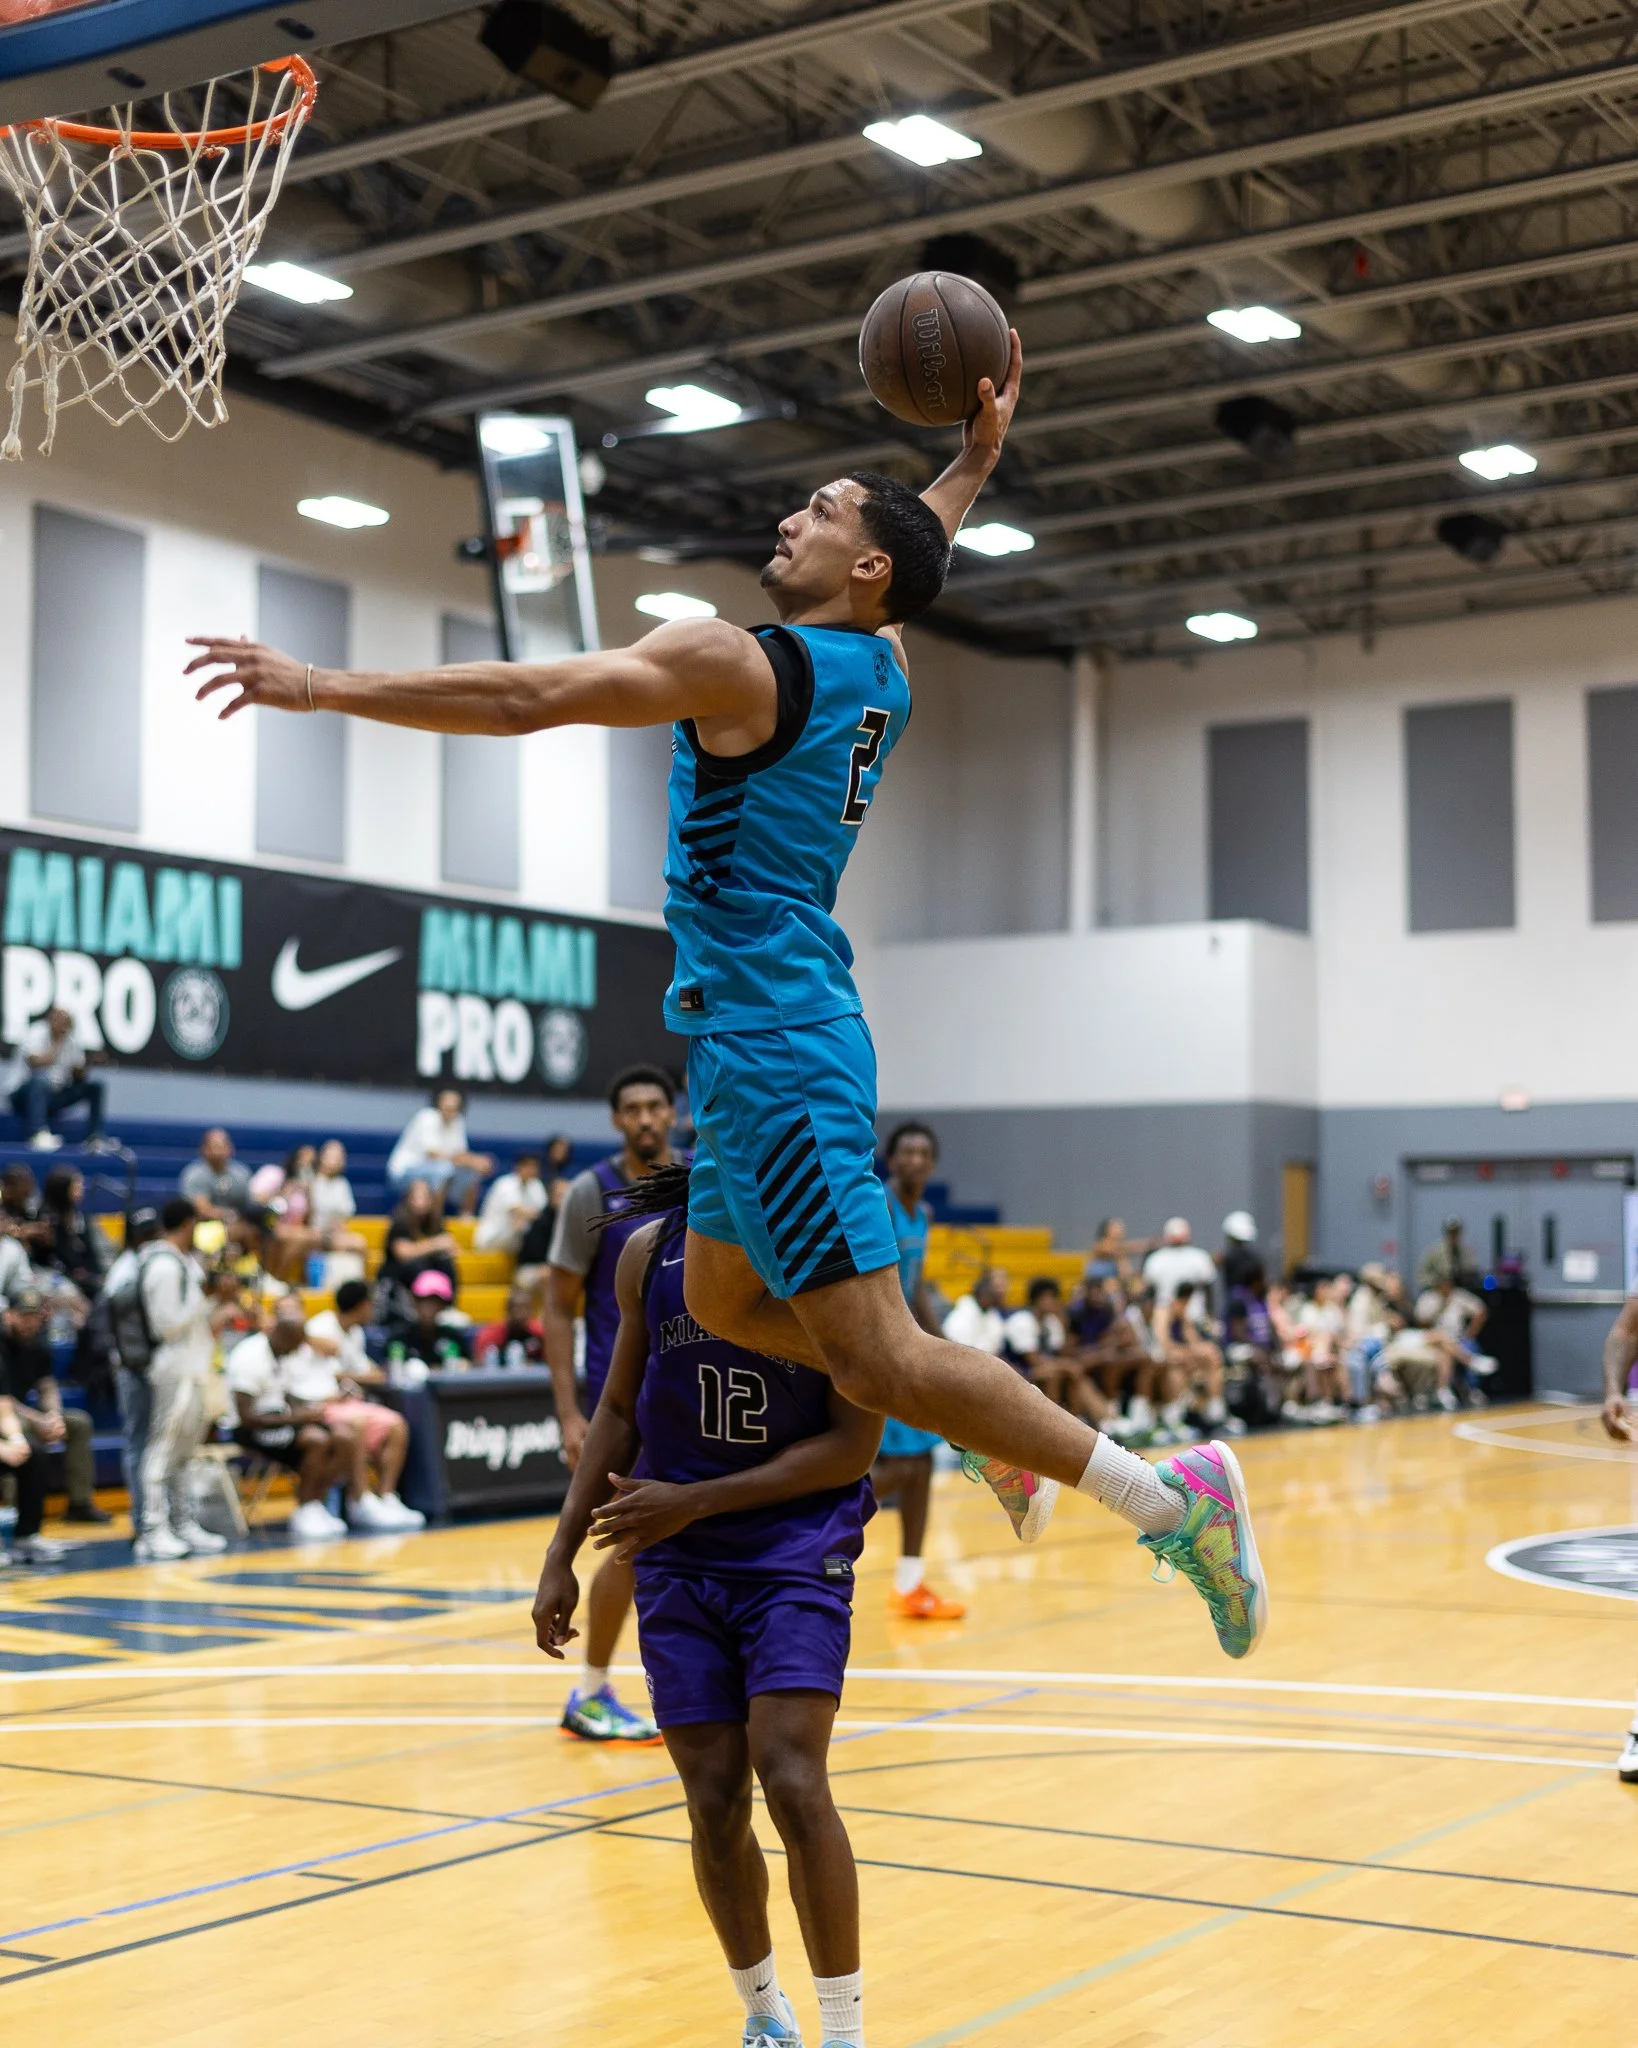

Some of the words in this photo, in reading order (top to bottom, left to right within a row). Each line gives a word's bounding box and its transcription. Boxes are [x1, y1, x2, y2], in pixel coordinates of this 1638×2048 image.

[911, 308, 948, 409] Wilson
[840, 706, 891, 826] 2
[3, 846, 243, 970] MIAMI
[419, 906, 598, 1009] MIAMI
[2, 944, 157, 1055] PRO
[417, 990, 535, 1084] PRO
[698, 1363, 768, 1444] 12
